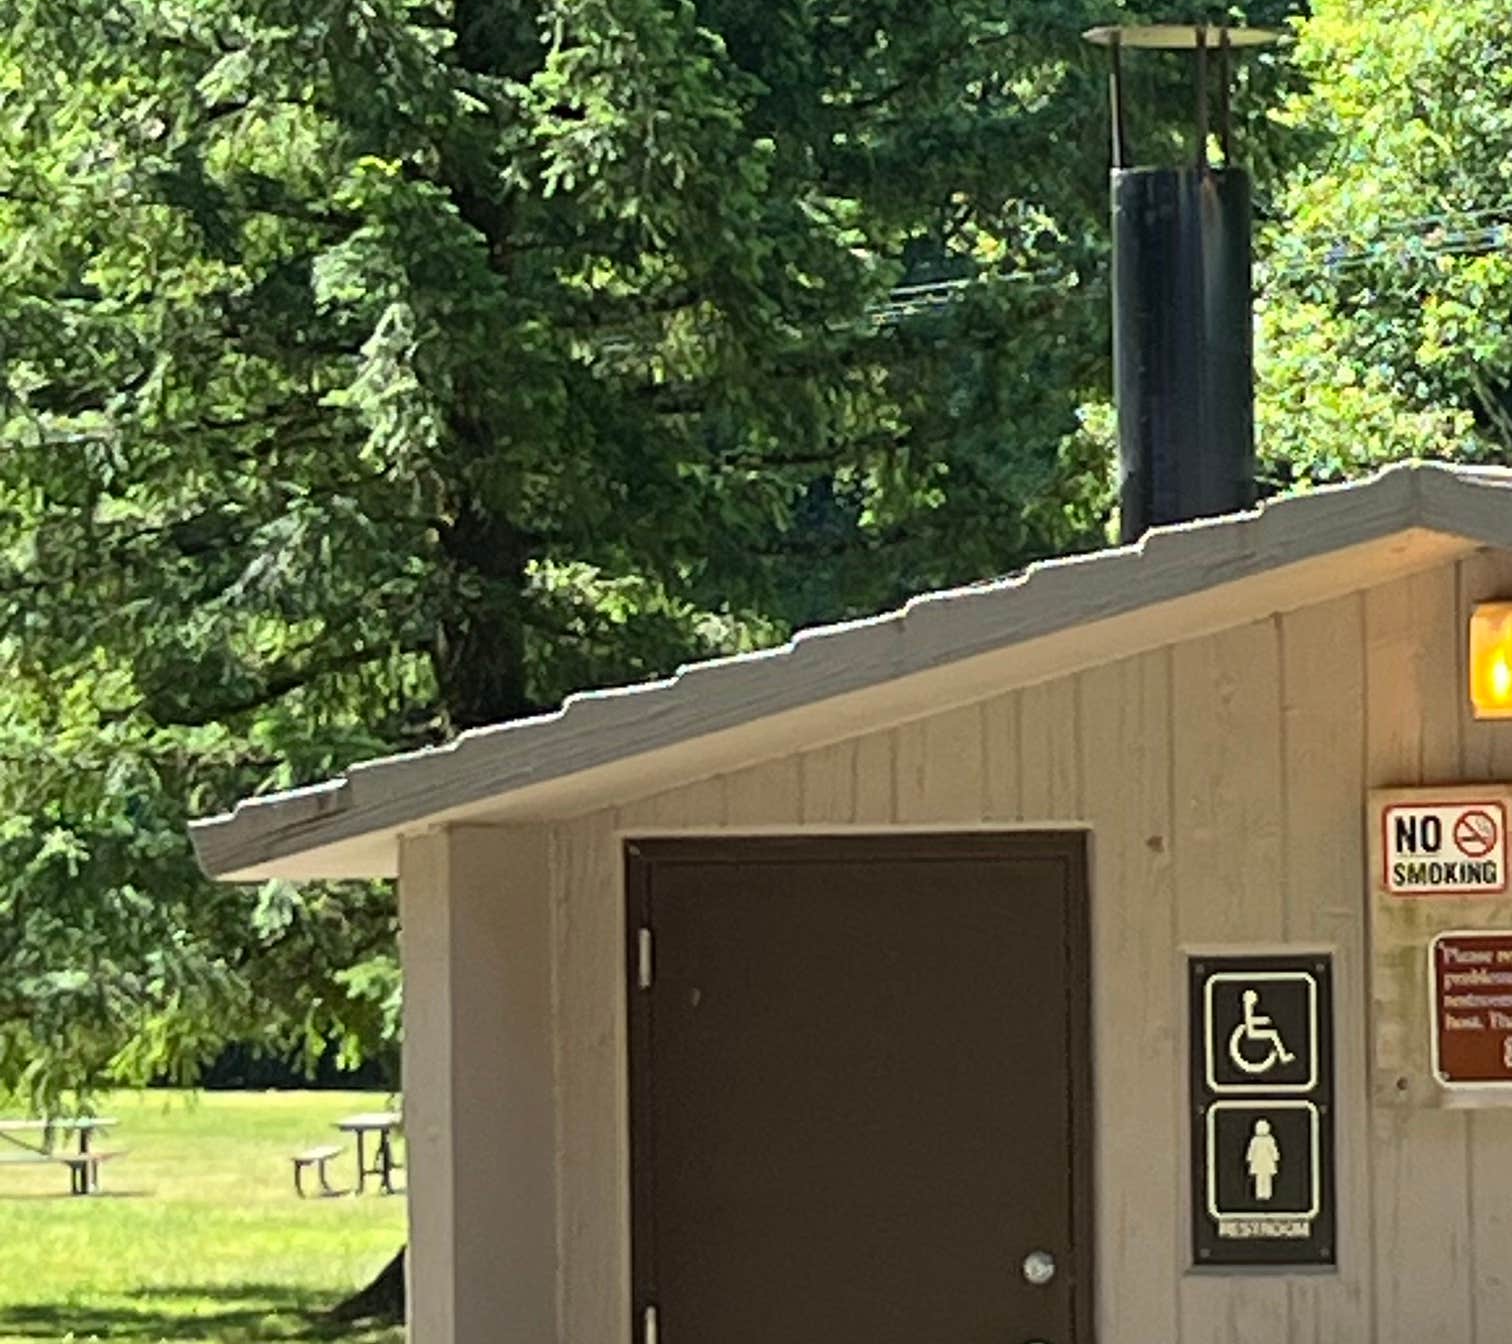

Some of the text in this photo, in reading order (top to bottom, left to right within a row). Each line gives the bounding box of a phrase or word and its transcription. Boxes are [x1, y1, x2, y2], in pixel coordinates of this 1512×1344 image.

[1395, 815, 1441, 853] NO
[1393, 860, 1498, 887] SMOKING
[1444, 947, 1494, 964] Please
[1219, 1222, 1310, 1238] RESTROOM
